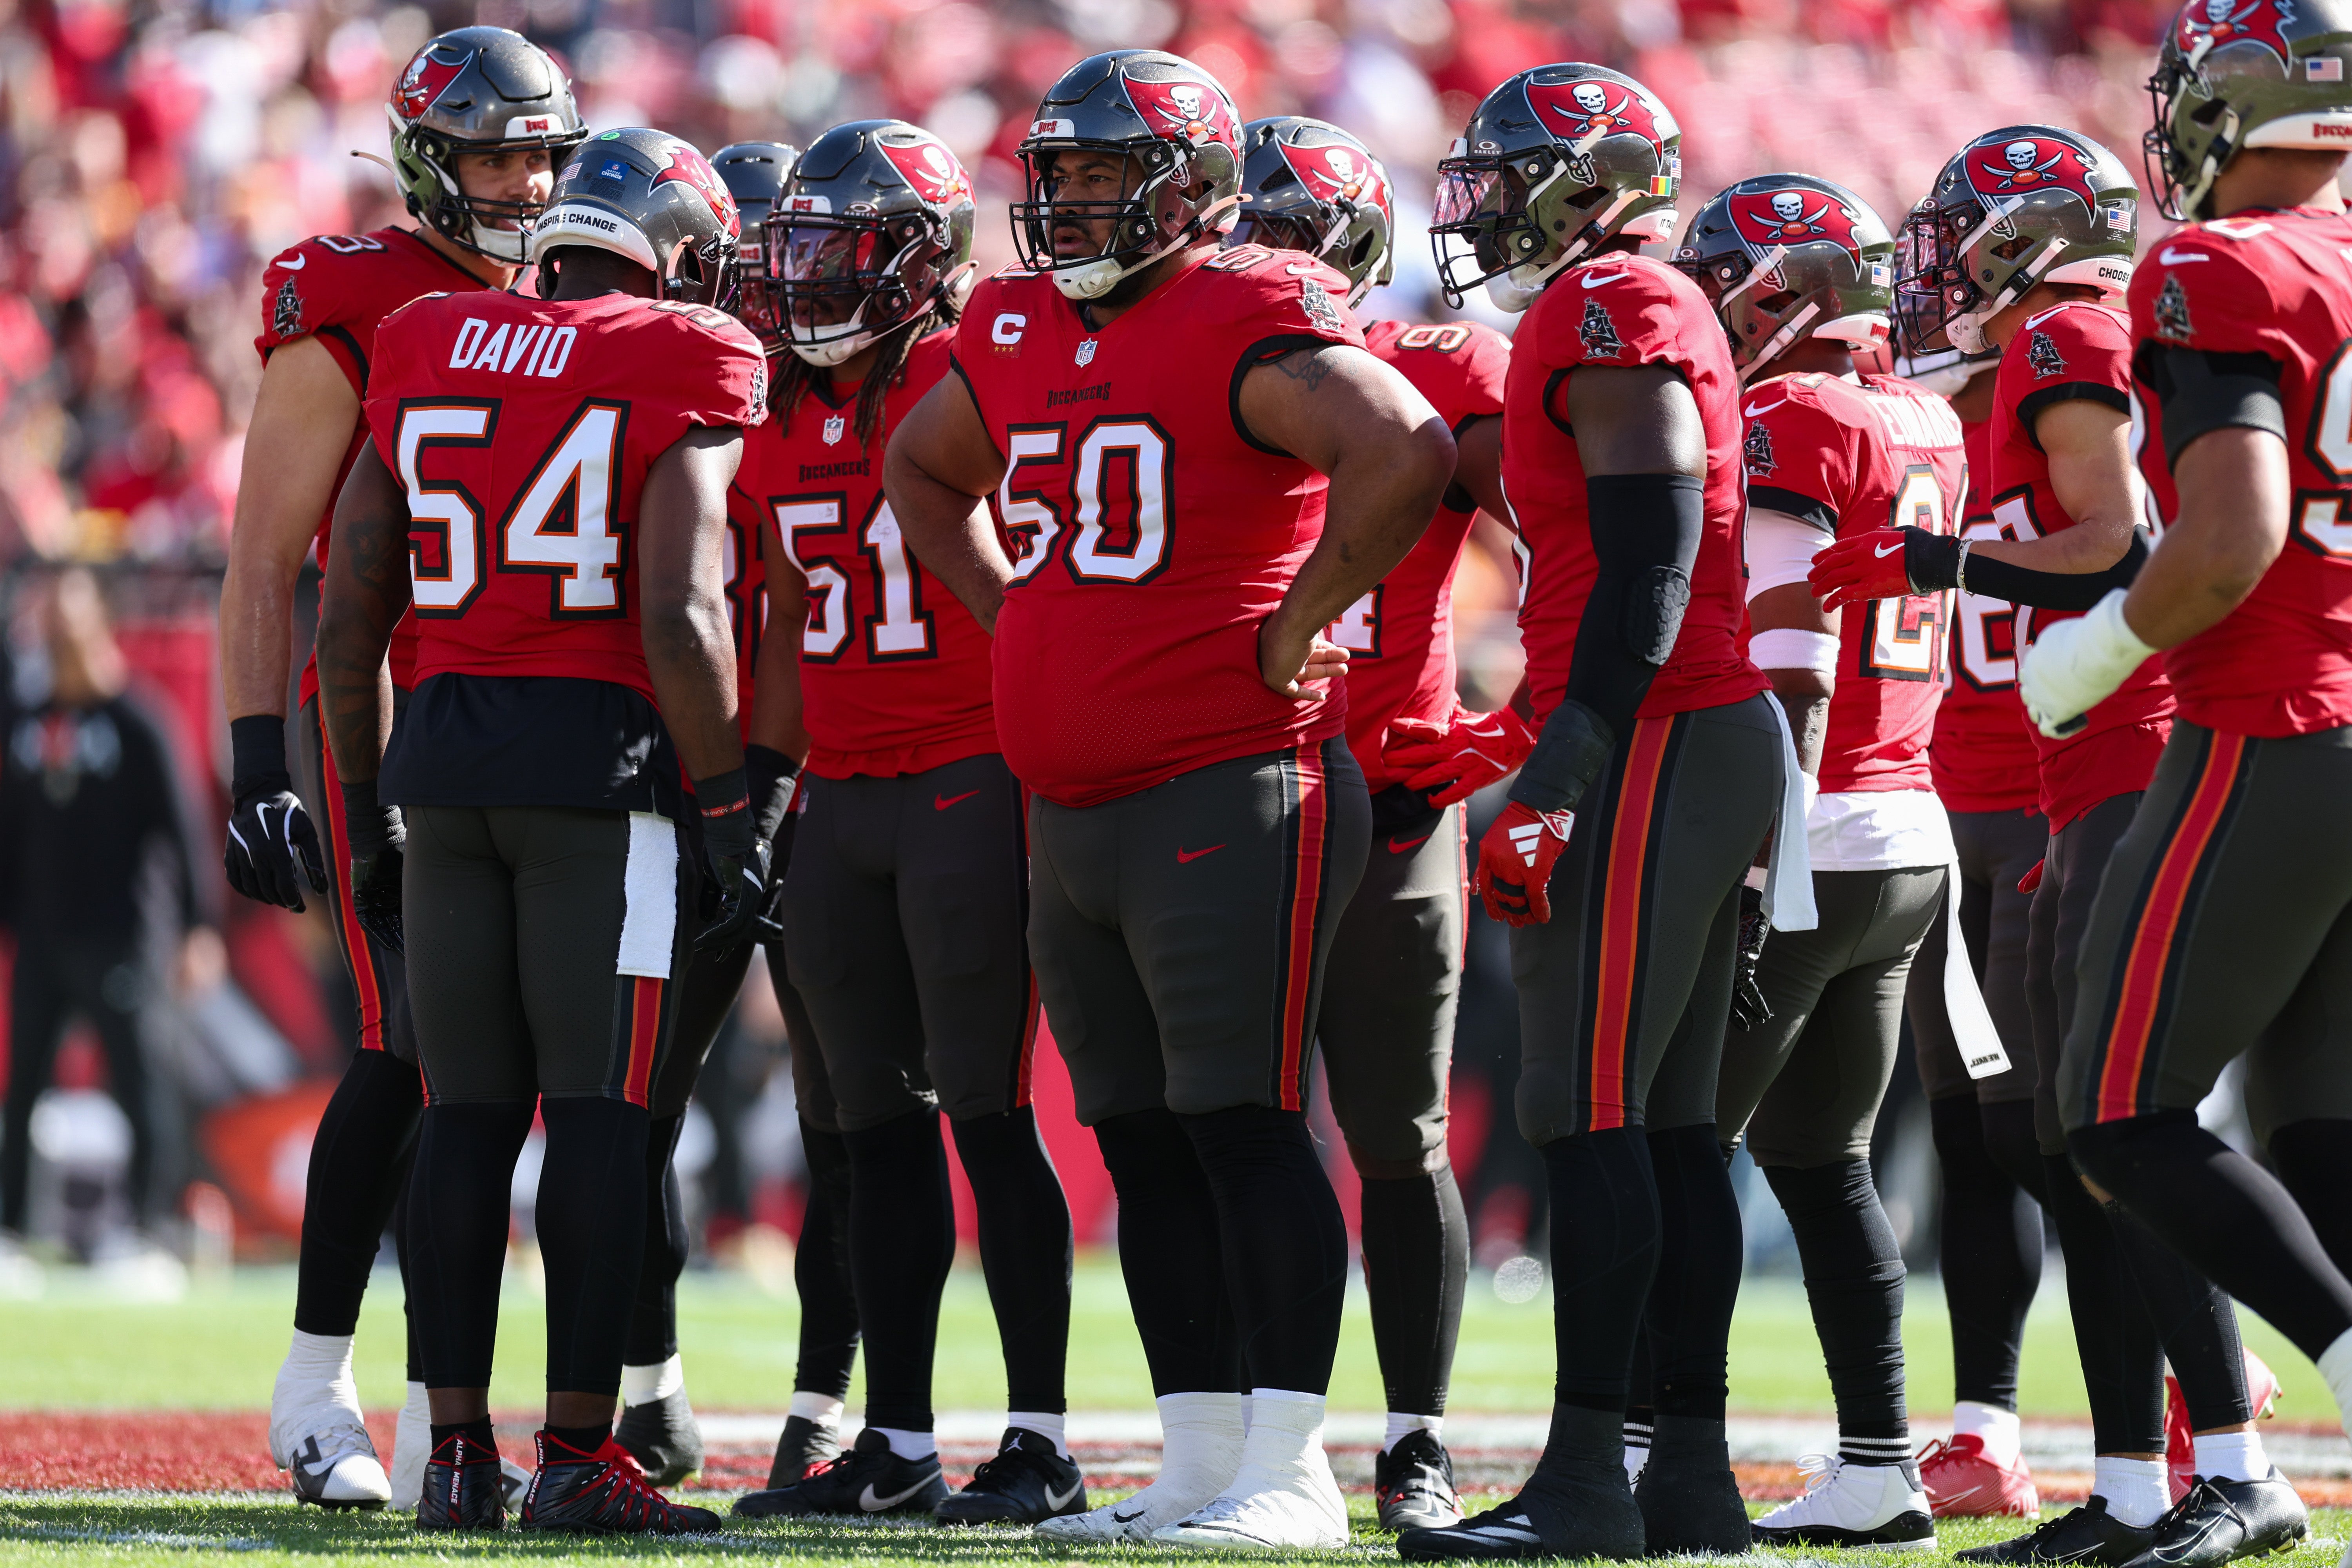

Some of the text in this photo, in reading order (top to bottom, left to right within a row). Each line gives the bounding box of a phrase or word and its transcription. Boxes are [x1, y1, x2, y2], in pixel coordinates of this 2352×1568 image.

[601, 171, 622, 180] CHANGE
[537, 213, 617, 233] INSPIRE CHANGE
[992, 314, 1026, 345] C
[449, 318, 577, 377] DAVID
[1078, 351, 1090, 361] NFL
[1047, 382, 1111, 408] BUCCANEERS
[799, 459, 870, 483] BUCCANEERS
[393, 396, 631, 619] 54
[1004, 414, 1175, 591] 50
[767, 489, 938, 664] 51
[732, 801, 744, 809] LOVE
[451, 1439, 463, 1504] ALPHA MENACE
[528, 1437, 544, 1504] ALPHA MENACE
